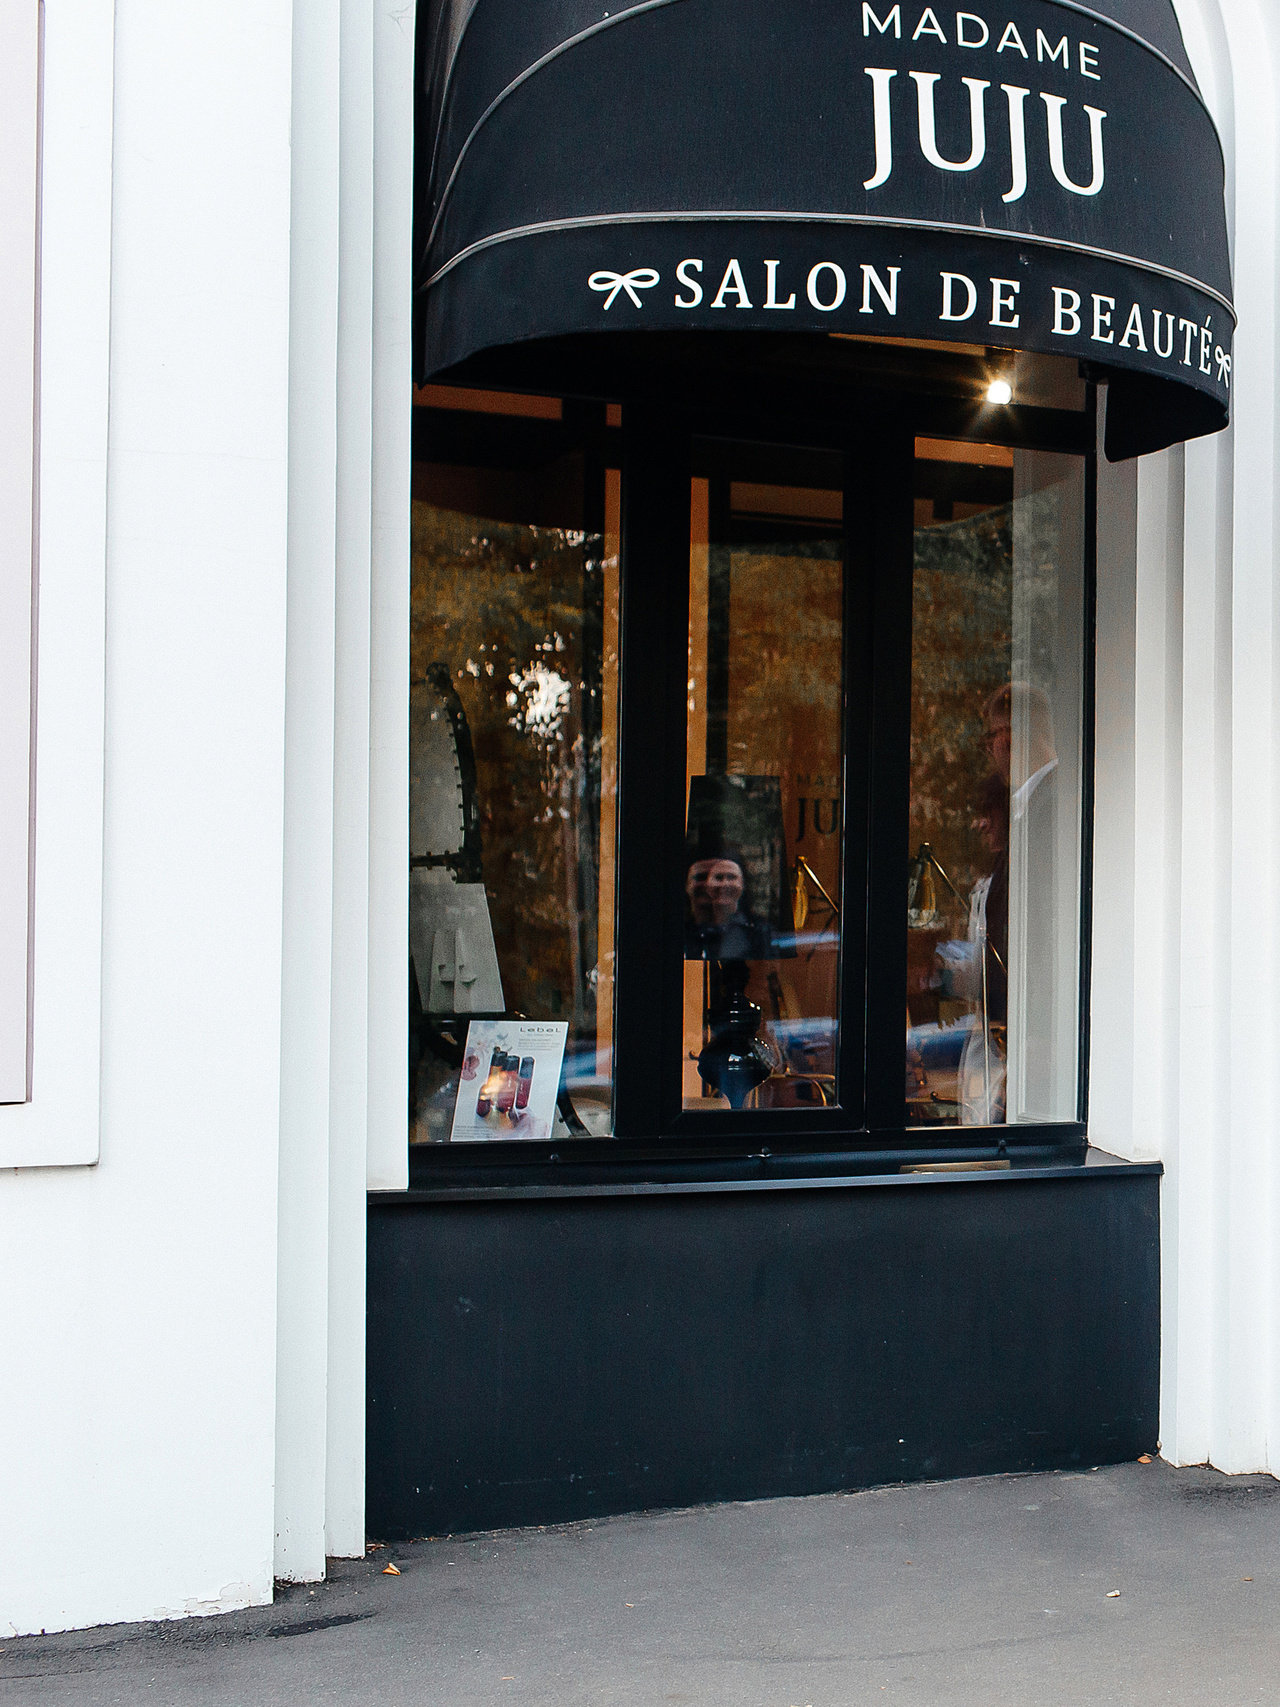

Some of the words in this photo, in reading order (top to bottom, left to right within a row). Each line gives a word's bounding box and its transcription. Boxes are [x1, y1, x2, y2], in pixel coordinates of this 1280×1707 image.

[862, 1, 1101, 81] MADAME
[862, 67, 1108, 204] JUJU
[674, 258, 902, 316] SALON
[938, 271, 1020, 329] DE
[1051, 286, 1213, 376] BEAUTÉ
